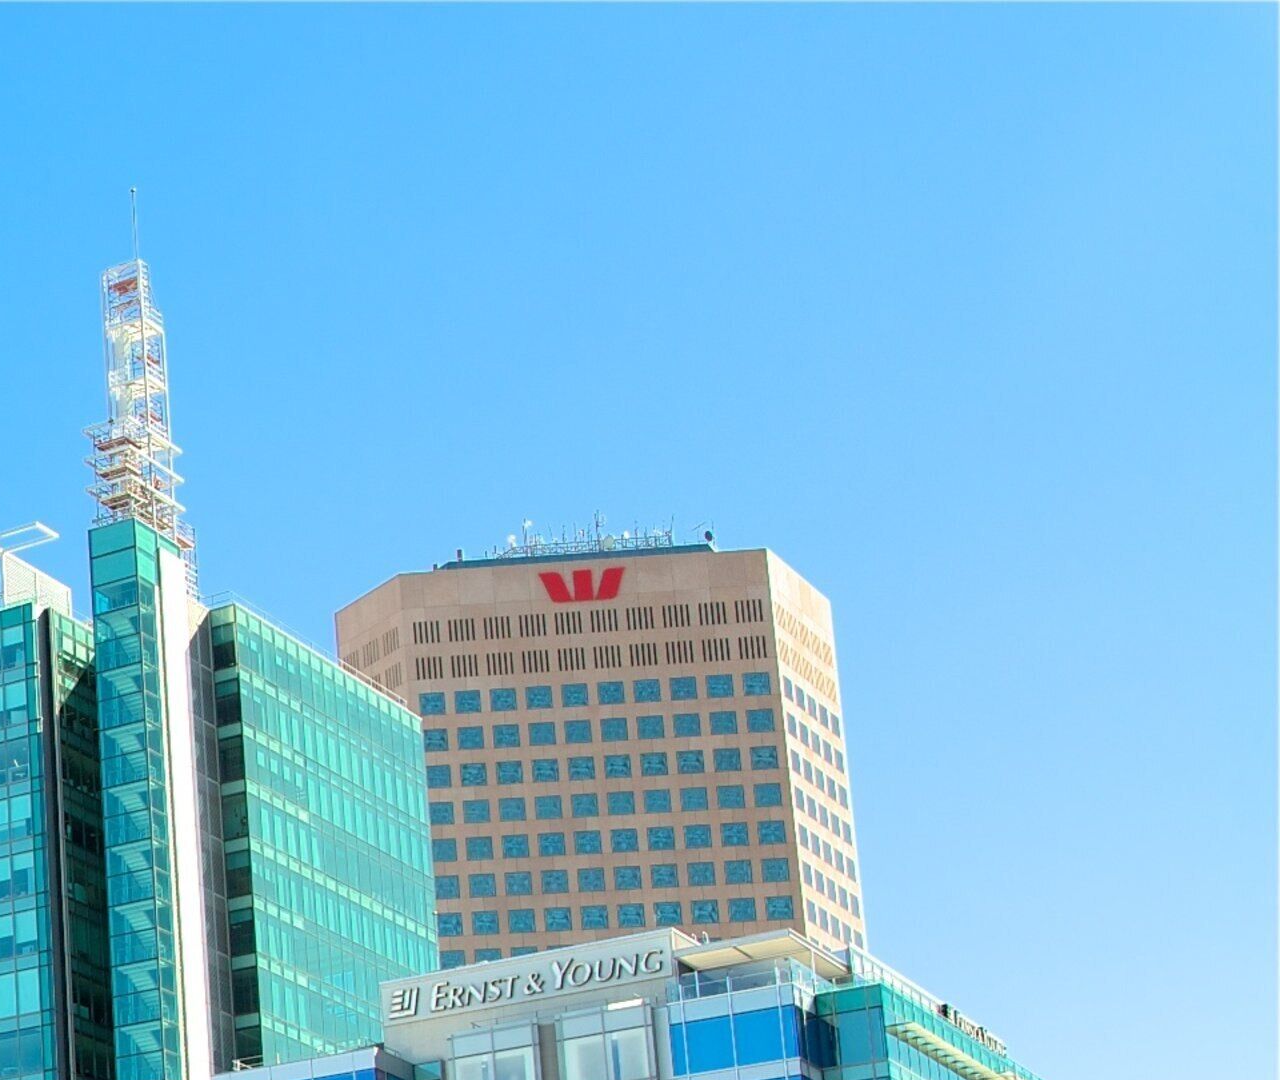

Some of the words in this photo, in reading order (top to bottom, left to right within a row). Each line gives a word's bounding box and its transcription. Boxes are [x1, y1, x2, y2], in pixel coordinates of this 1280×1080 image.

[430, 975, 520, 1013] ERNST
[524, 972, 545, 996] &
[551, 950, 663, 991] YOUNG
